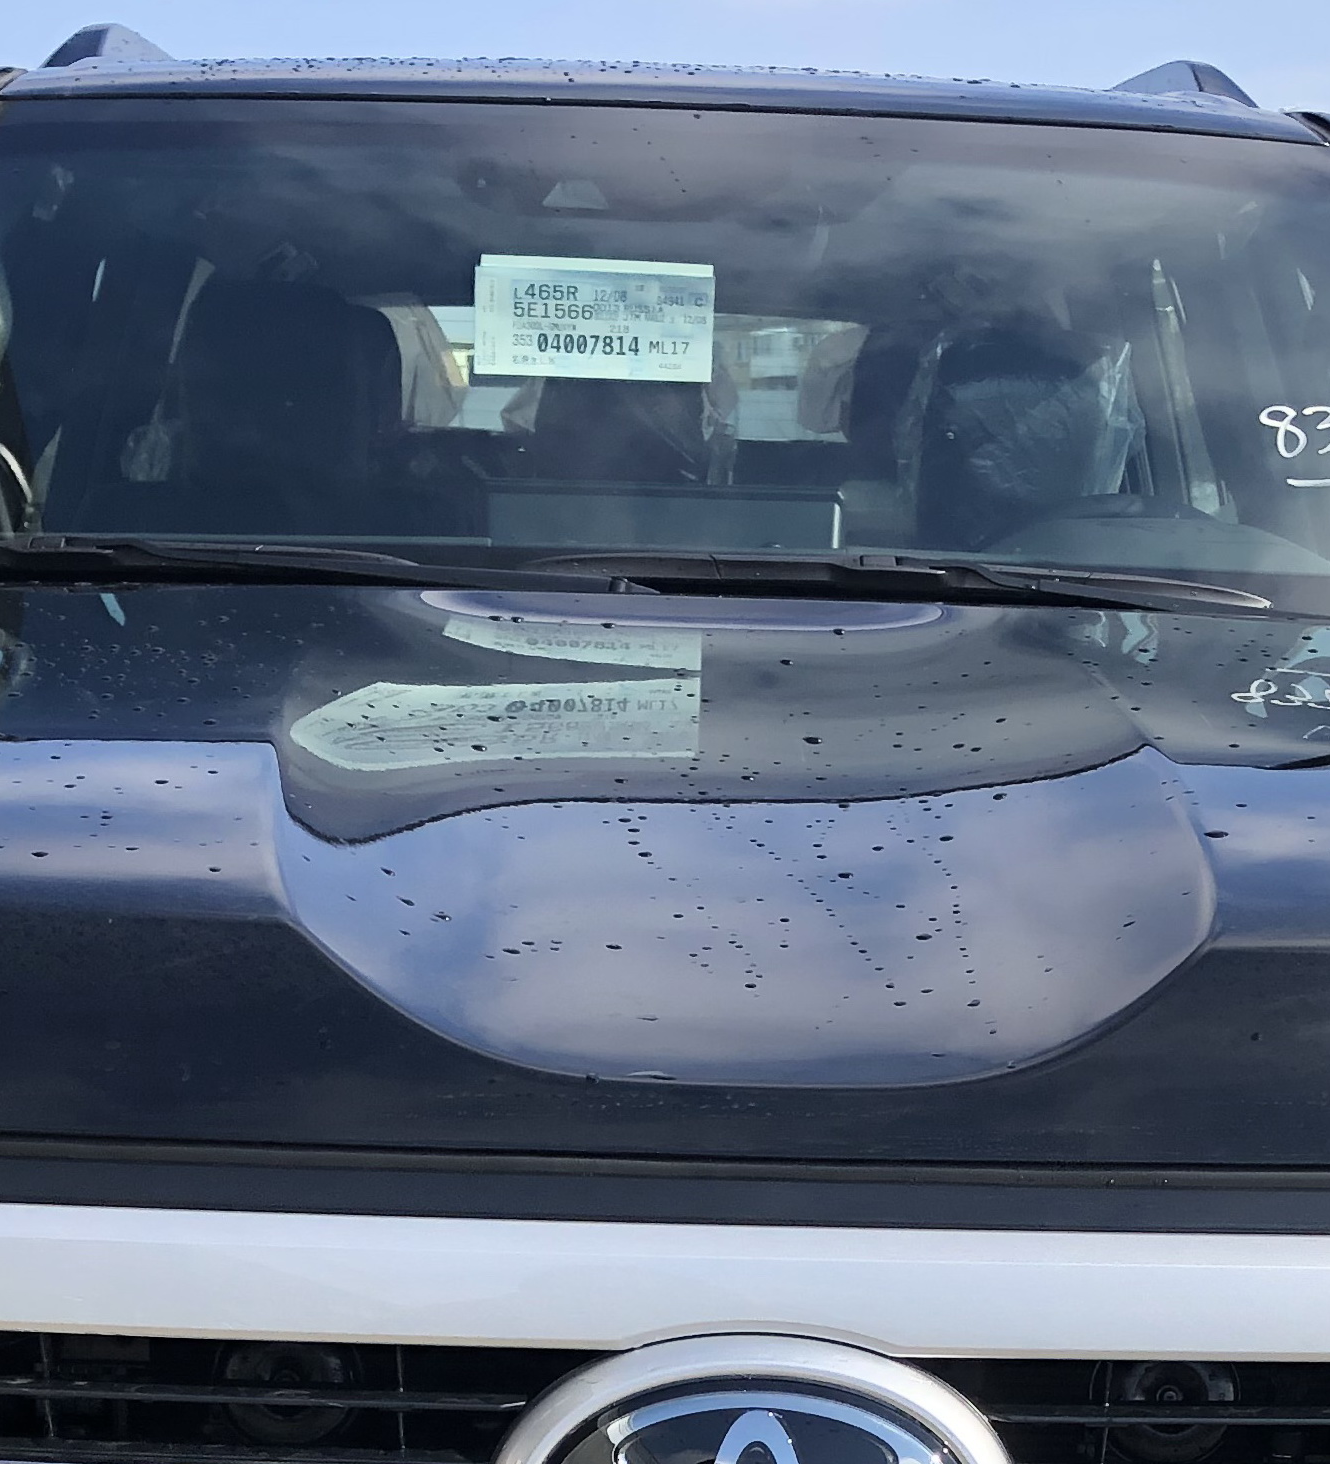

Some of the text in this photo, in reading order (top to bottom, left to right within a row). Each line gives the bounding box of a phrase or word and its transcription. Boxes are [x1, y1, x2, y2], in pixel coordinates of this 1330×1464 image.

[513, 301, 594, 321] 5E1566
[537, 333, 640, 356] 04007814
[648, 340, 690, 355] ML17
